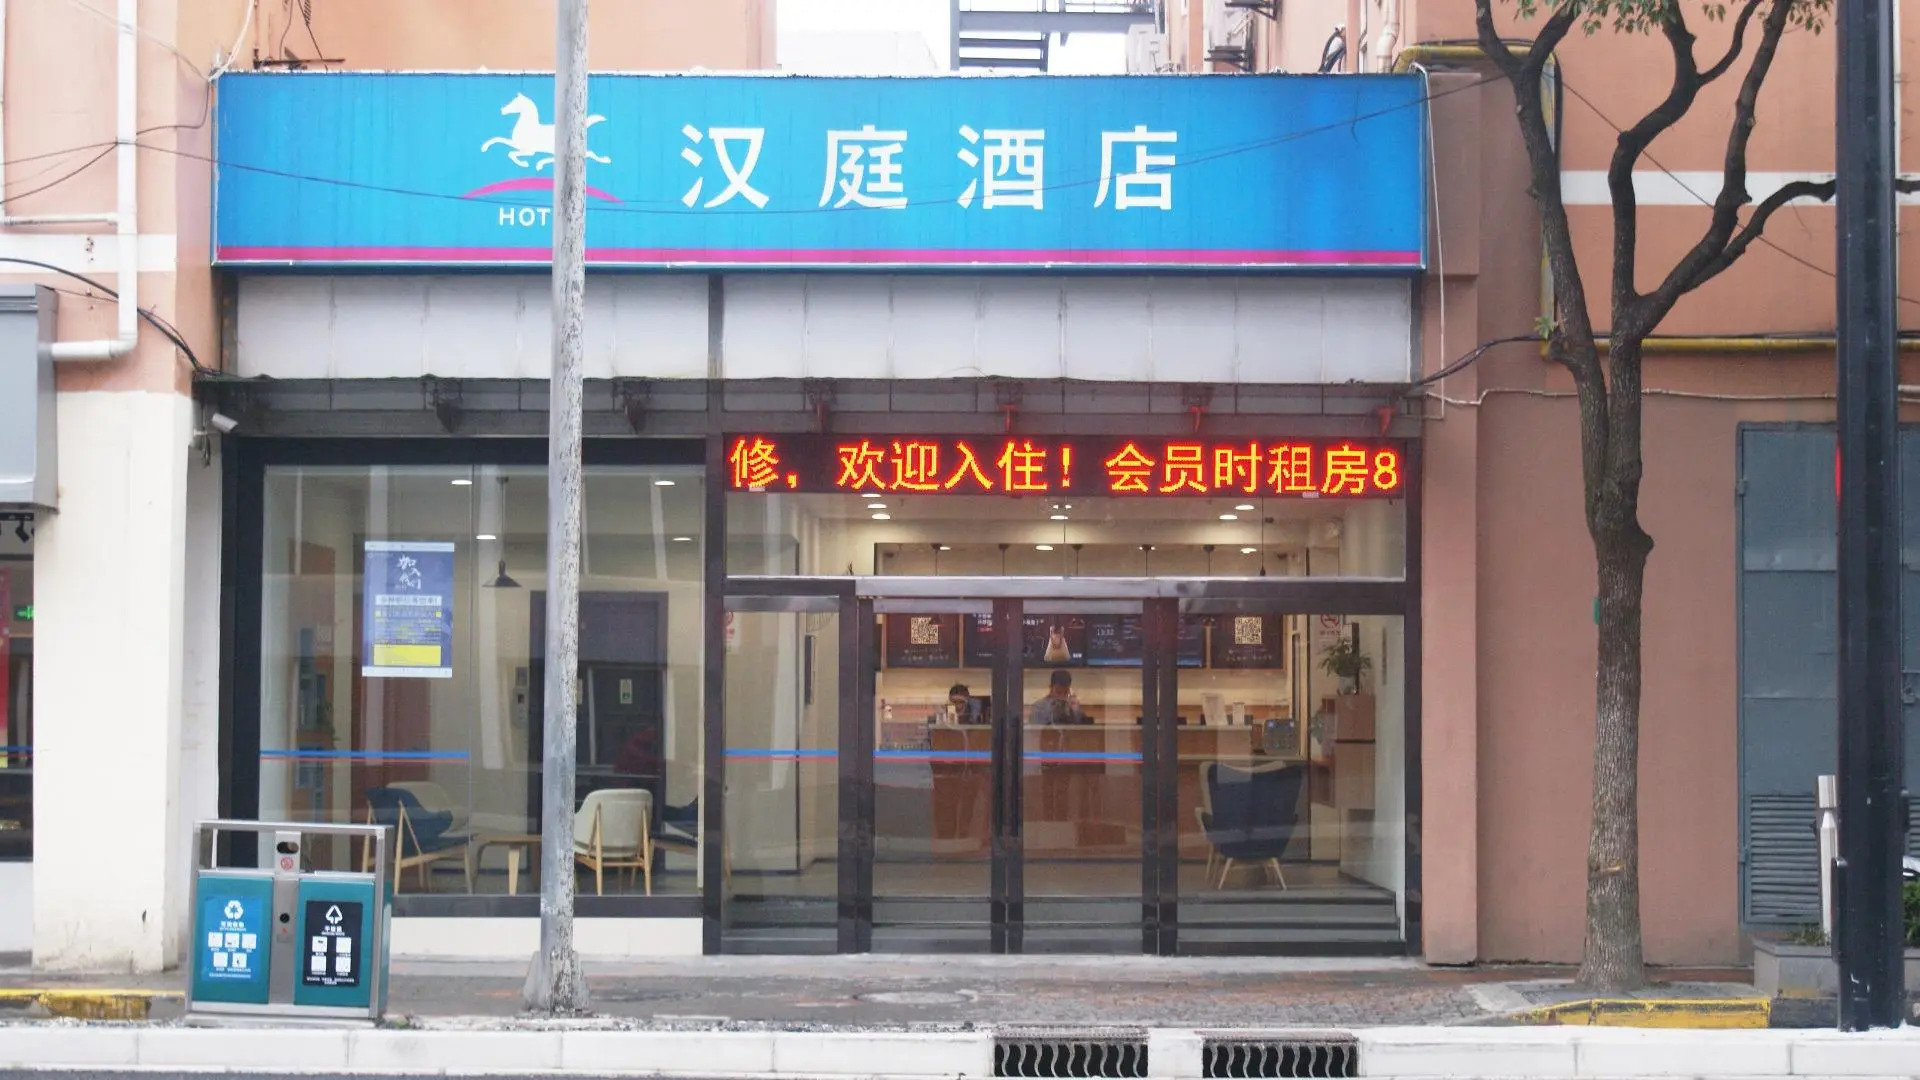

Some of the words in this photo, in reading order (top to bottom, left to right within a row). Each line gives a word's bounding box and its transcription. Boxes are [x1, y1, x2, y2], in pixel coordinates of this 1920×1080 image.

[681, 124, 1178, 210] 汉庭酒店
[499, 207, 551, 227] HOT
